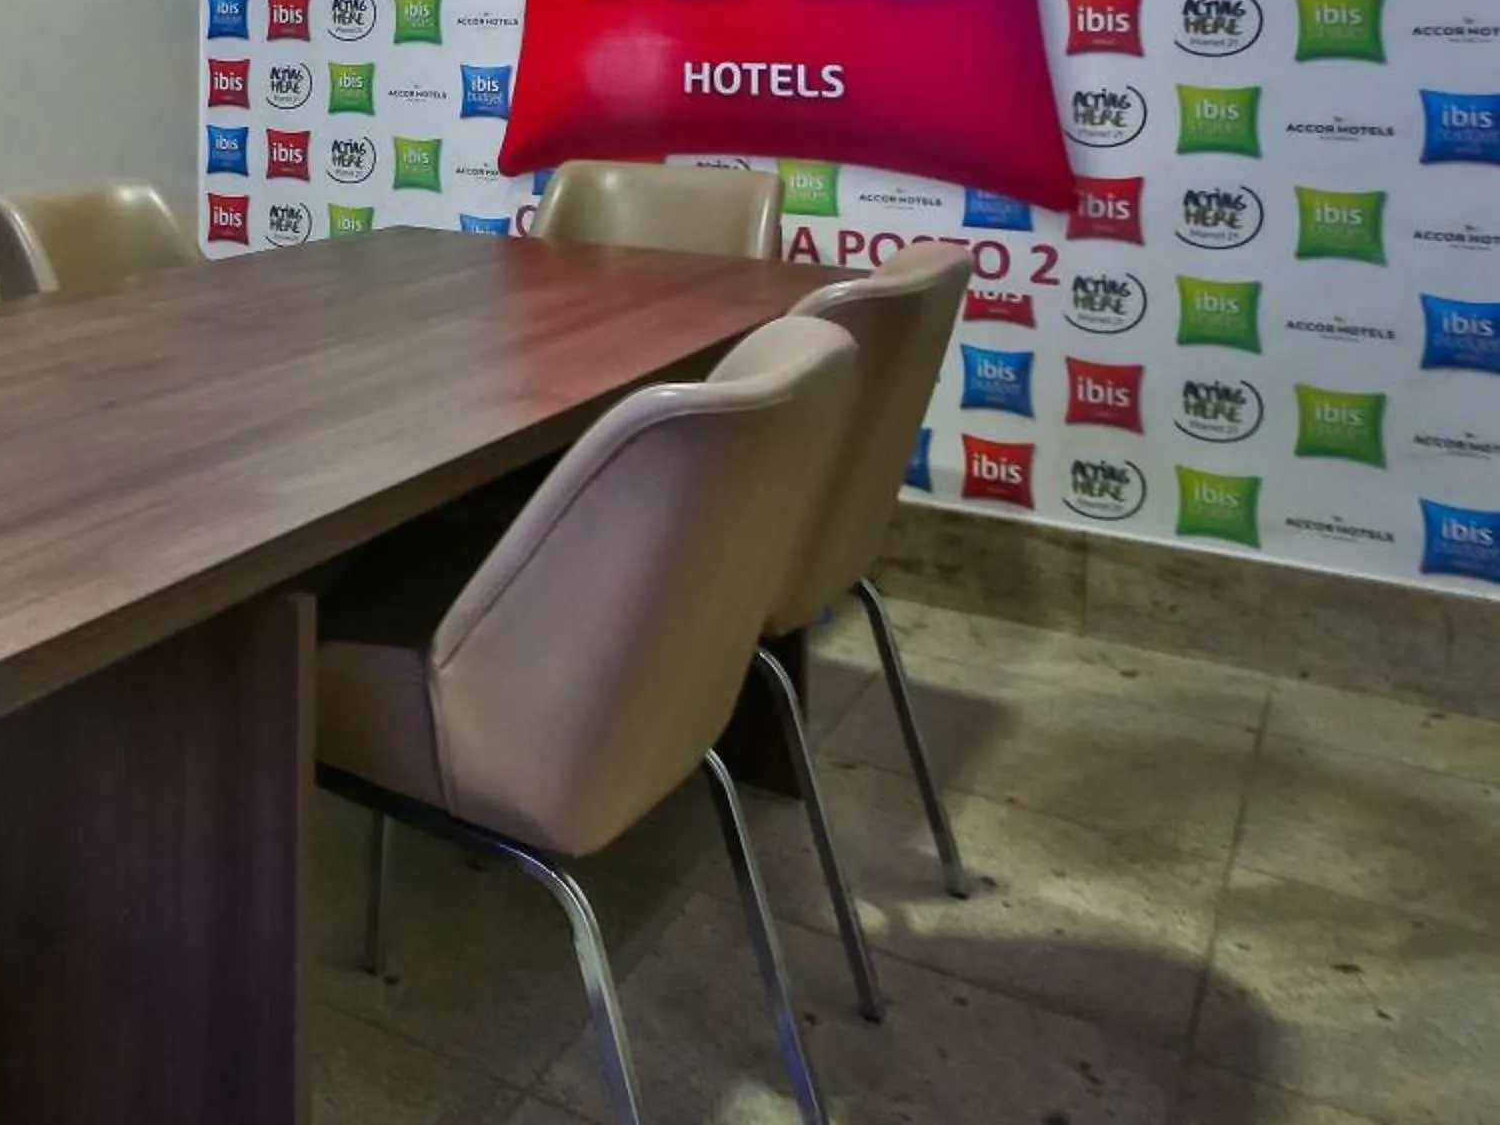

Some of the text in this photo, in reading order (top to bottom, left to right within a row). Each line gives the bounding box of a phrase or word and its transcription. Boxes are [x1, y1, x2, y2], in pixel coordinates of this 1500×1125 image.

[216, 2, 239, 14] ibis
[272, 5, 303, 24] ibis
[404, 2, 430, 16] ibis
[1315, 5, 1362, 27] ibis
[1077, 7, 1130, 32] ibis
[214, 72, 243, 91] ibis
[339, 76, 362, 88] ibis
[471, 75, 499, 93] ibis
[683, 60, 845, 99] HOTELS
[1193, 95, 1239, 121] ibis
[1442, 103, 1493, 129] ibis
[215, 135, 238, 149] ibis
[273, 144, 302, 163] ibis
[403, 149, 429, 164] ibis
[790, 169, 824, 188] ibis
[1077, 190, 1130, 219] ibis
[1314, 200, 1362, 225] ibis
[213, 207, 243, 226] ibis
[338, 218, 361, 231] ibis
[1030, 244, 1060, 286] 2
[1192, 289, 1240, 314] ibis
[1442, 313, 1493, 336] ibis
[977, 362, 1015, 382] ibis
[1076, 376, 1130, 407] ibis
[1313, 401, 1363, 424] ibis
[971, 453, 1021, 483] ibis
[1193, 481, 1240, 507] ibis
[1442, 516, 1493, 545] ibis
